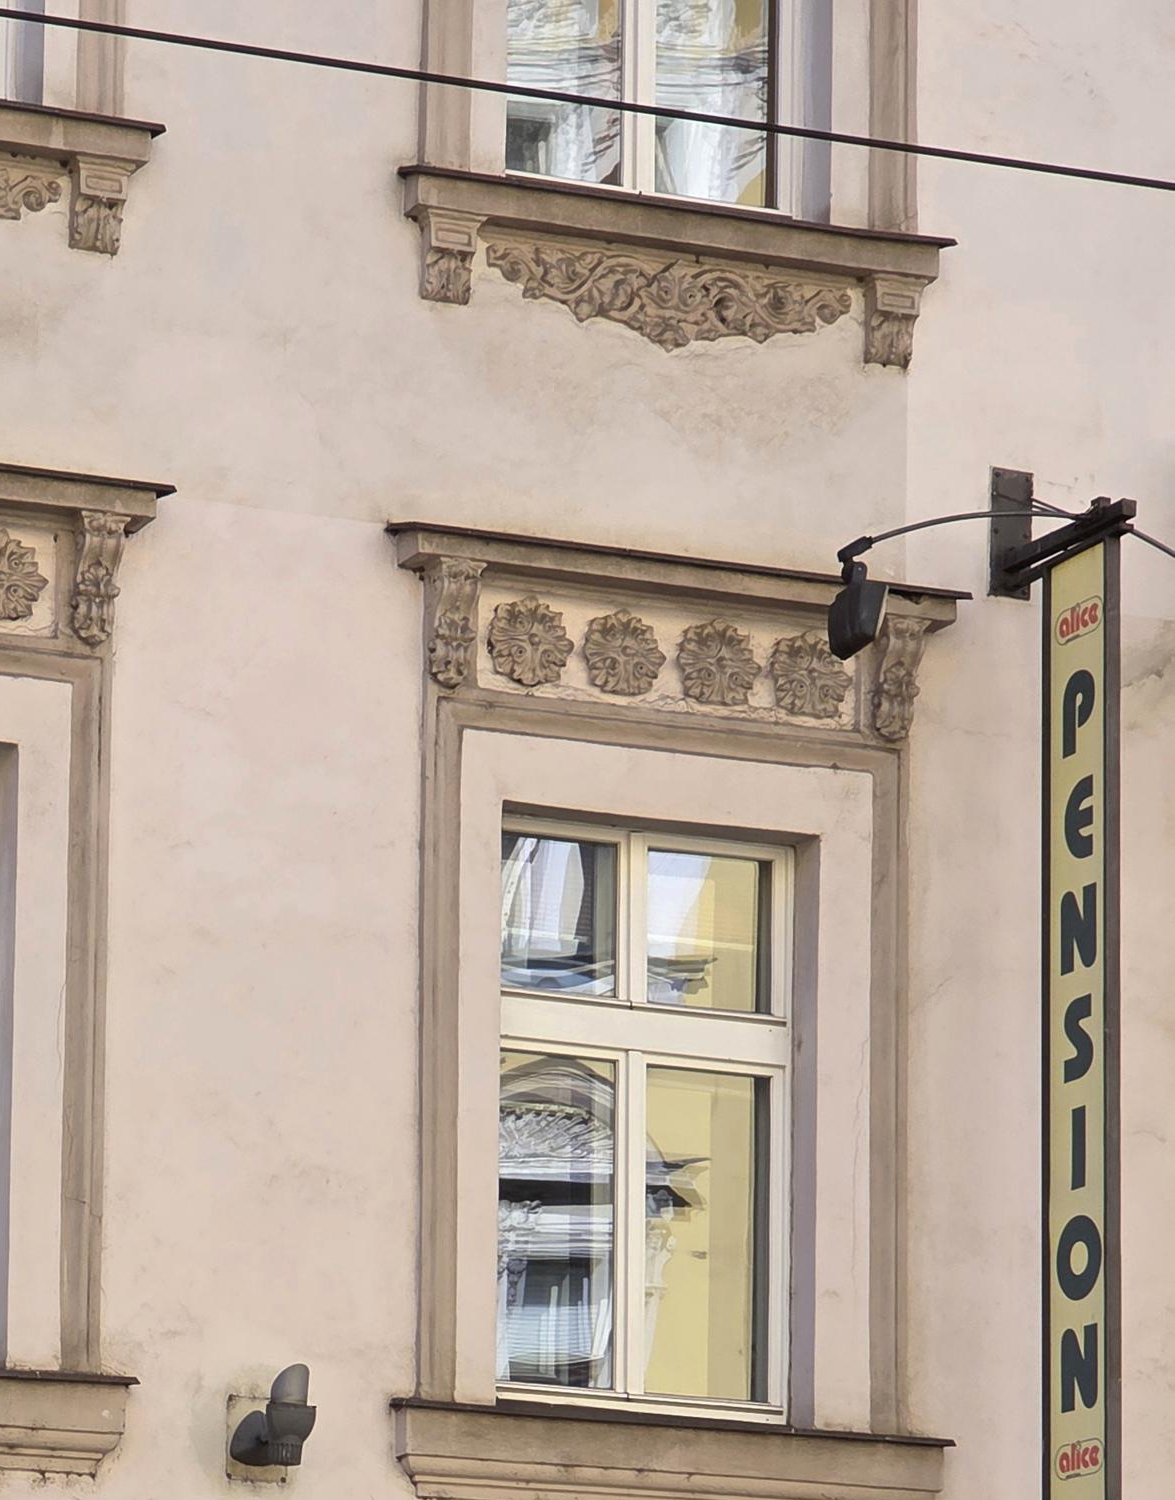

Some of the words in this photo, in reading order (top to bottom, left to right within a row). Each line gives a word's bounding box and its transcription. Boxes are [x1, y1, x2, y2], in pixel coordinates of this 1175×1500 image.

[1058, 602, 1099, 639] alice
[1056, 669, 1102, 1414] PENSION
[1058, 1442, 1100, 1474] alice
